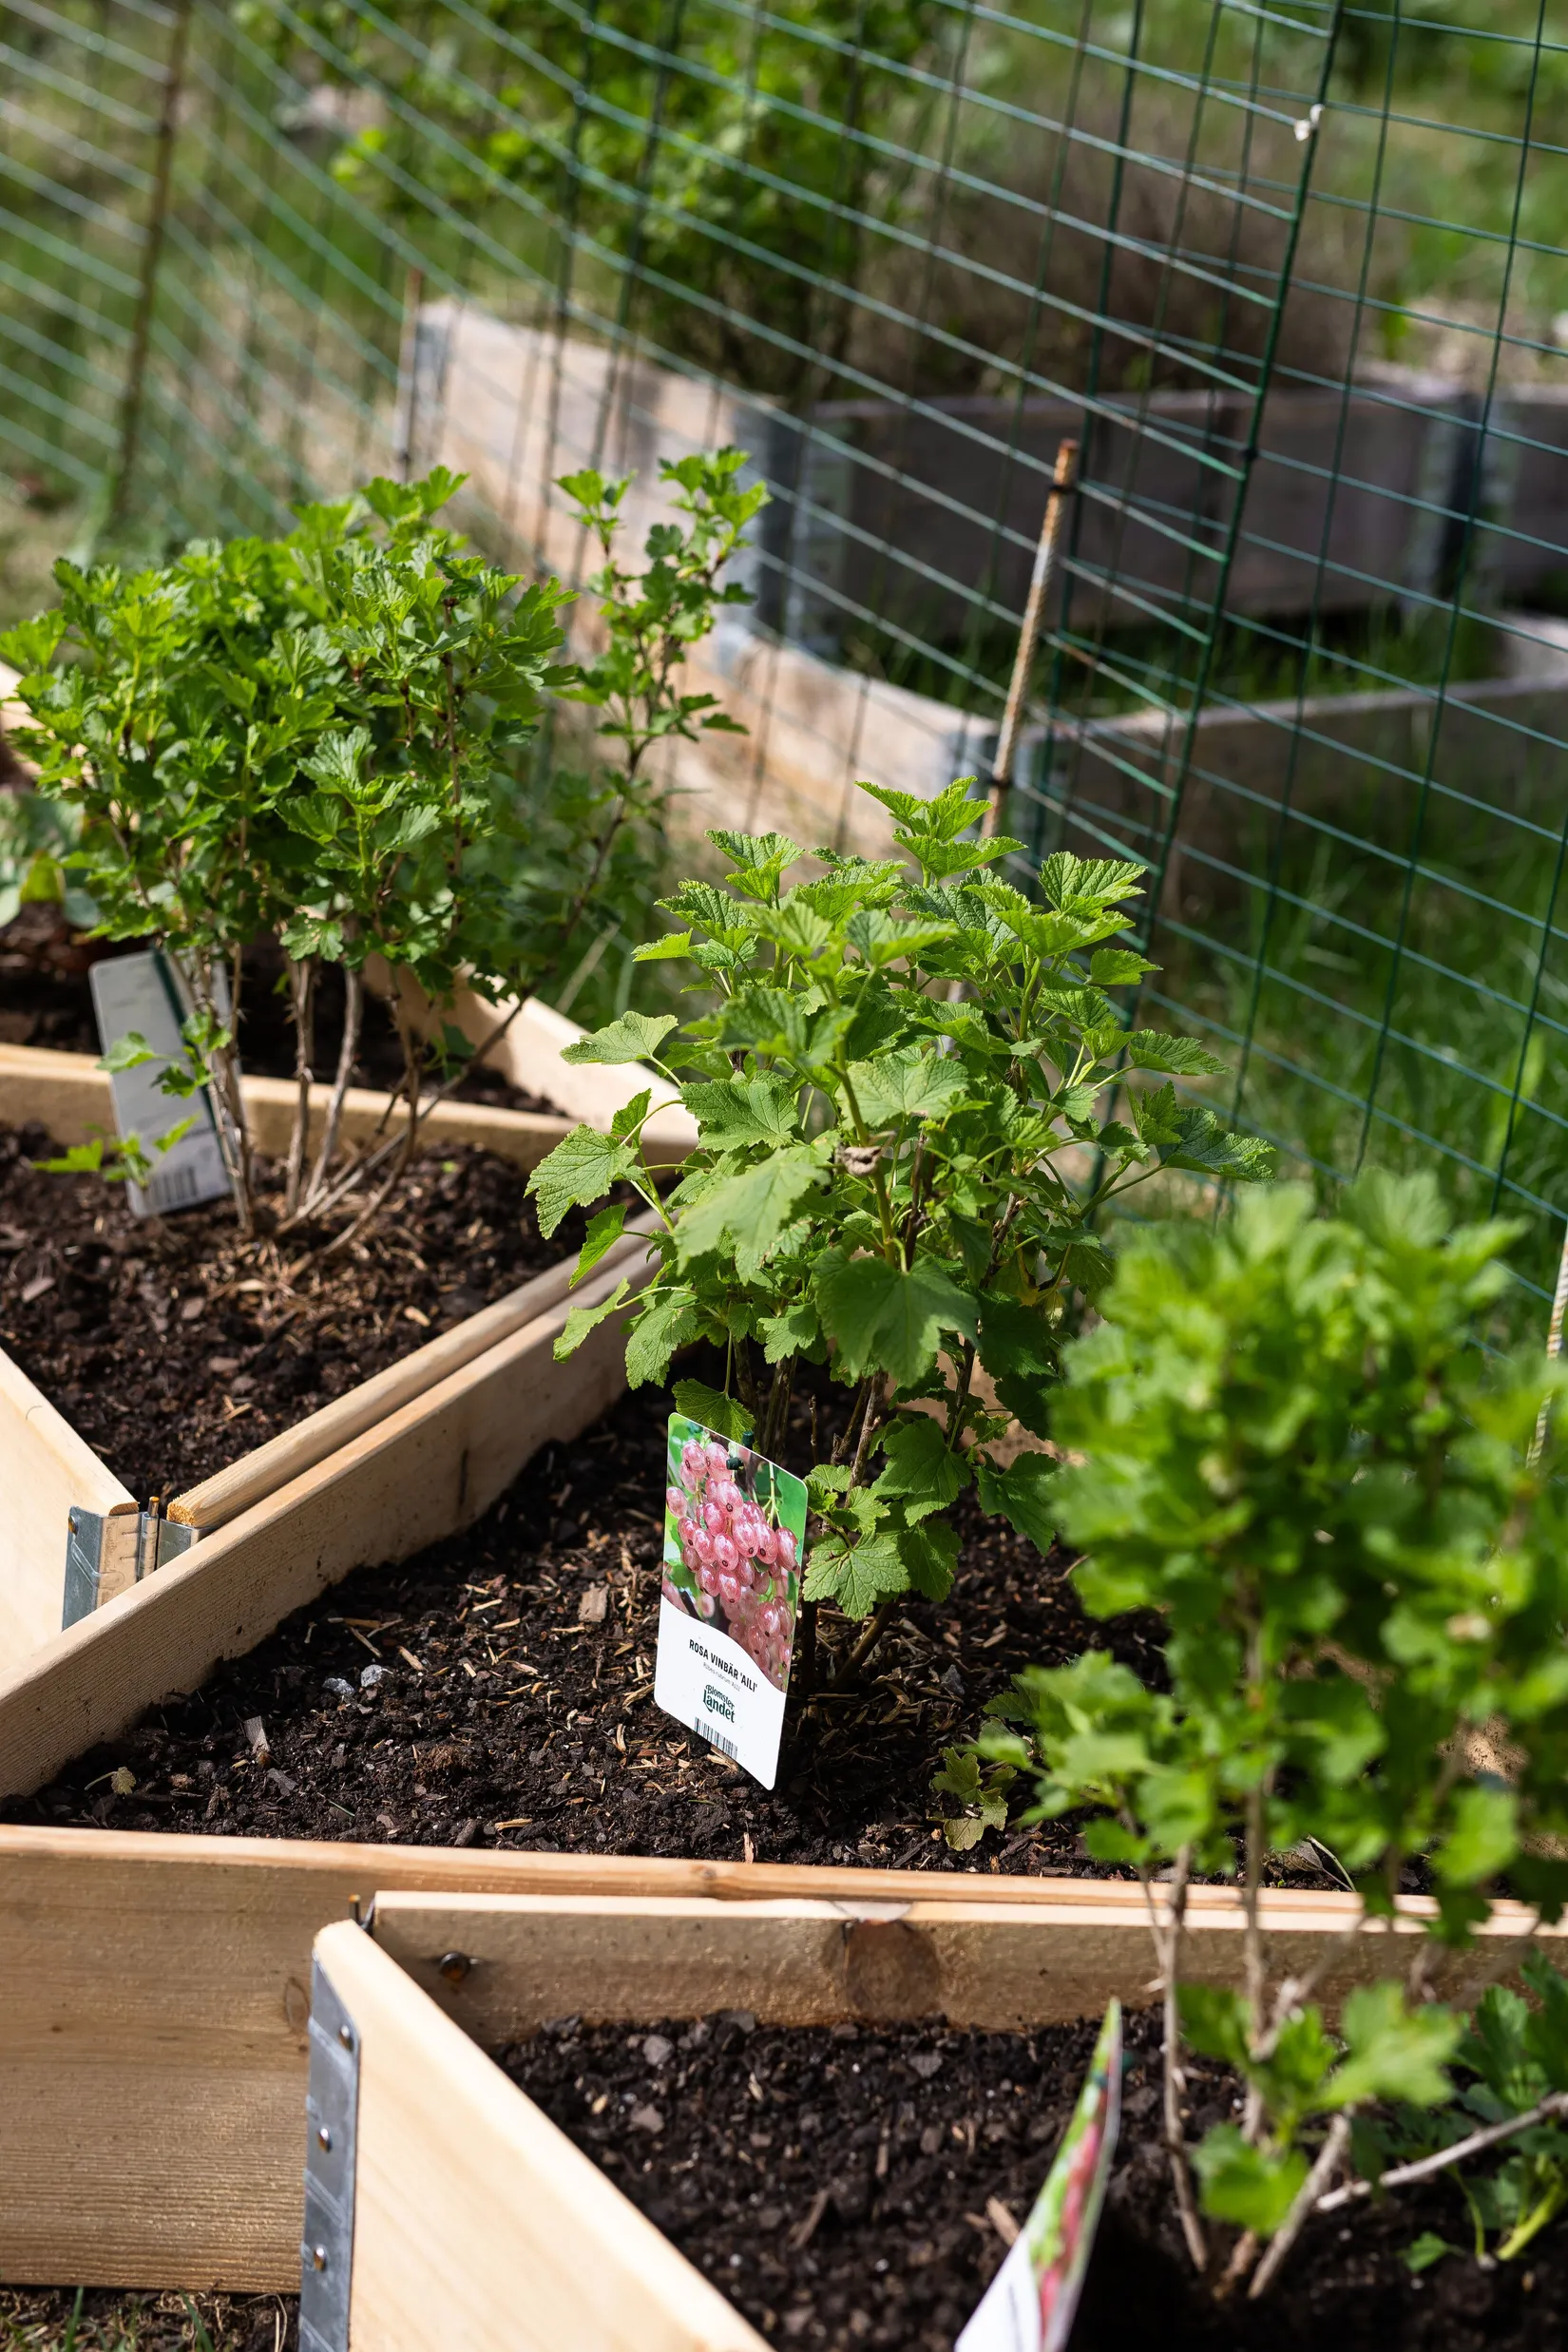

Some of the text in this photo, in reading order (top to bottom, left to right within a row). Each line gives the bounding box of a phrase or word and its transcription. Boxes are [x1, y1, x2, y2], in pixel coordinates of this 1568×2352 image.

[689, 1639, 709, 1660] ROSA
[710, 1653, 738, 1680] VINBÄR
[702, 1689, 736, 1723] Landet
[705, 1684, 736, 1710] Blomster
